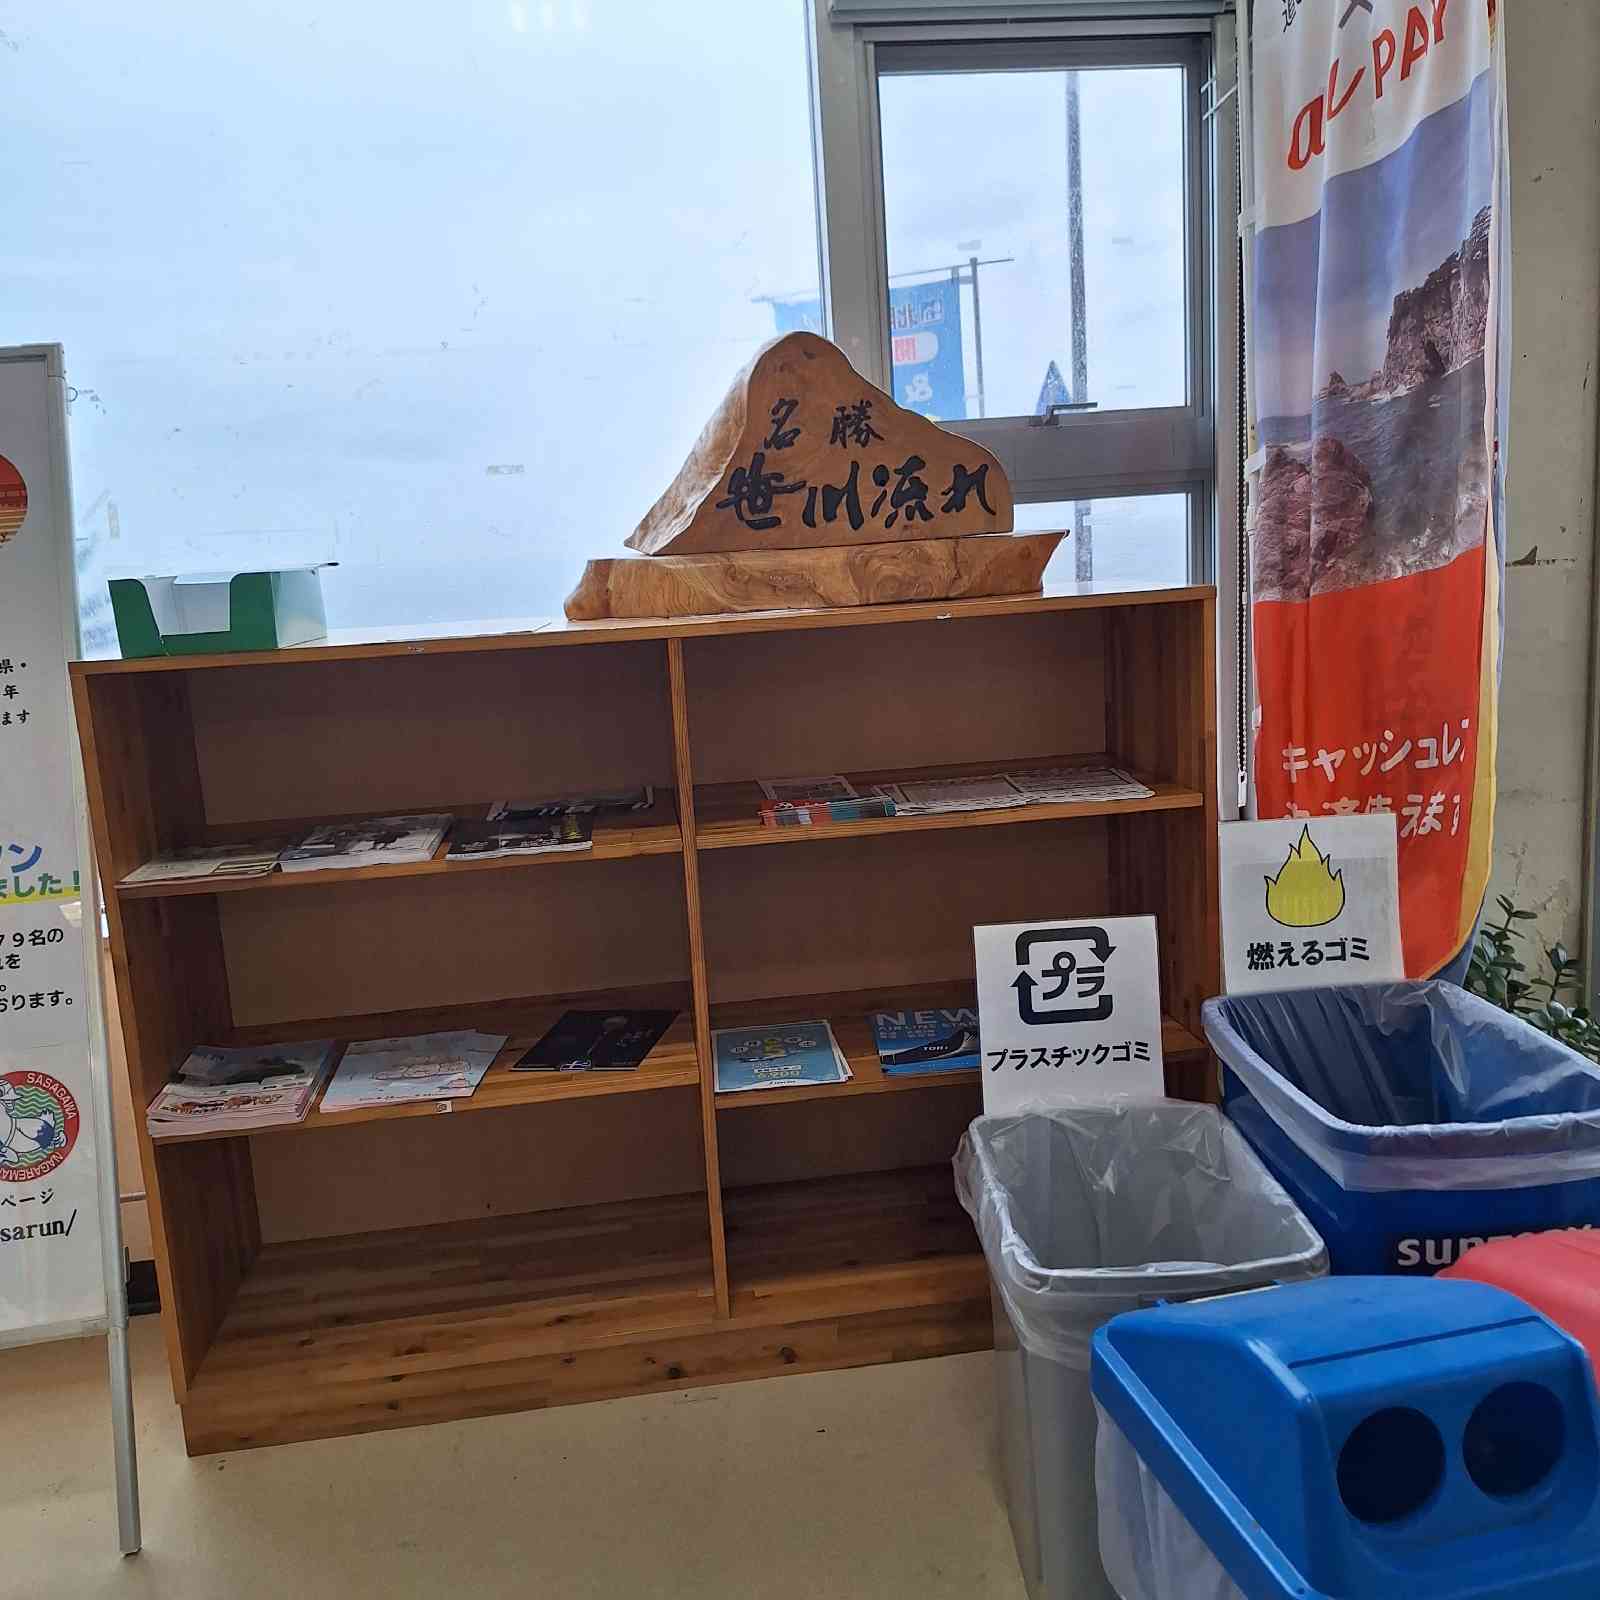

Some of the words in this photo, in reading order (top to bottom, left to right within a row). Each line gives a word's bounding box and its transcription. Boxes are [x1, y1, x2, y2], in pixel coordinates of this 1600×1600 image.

[1371, 0, 1448, 100] PAY
[2, 684, 20, 700] 年
[1, 708, 31, 726] ます
[0, 843, 43, 874] ン
[0, 952, 21, 970] を
[1246, 936, 1371, 971] 燃えるゴミ
[1041, 951, 1105, 1001] プラ
[986, 1041, 1151, 1072] プラスチックゴミ
[26, 1072, 77, 1120] SASAGAWA
[0, 1151, 64, 1181] NAGAREMA
[0, 1208, 78, 1242] sarun/
